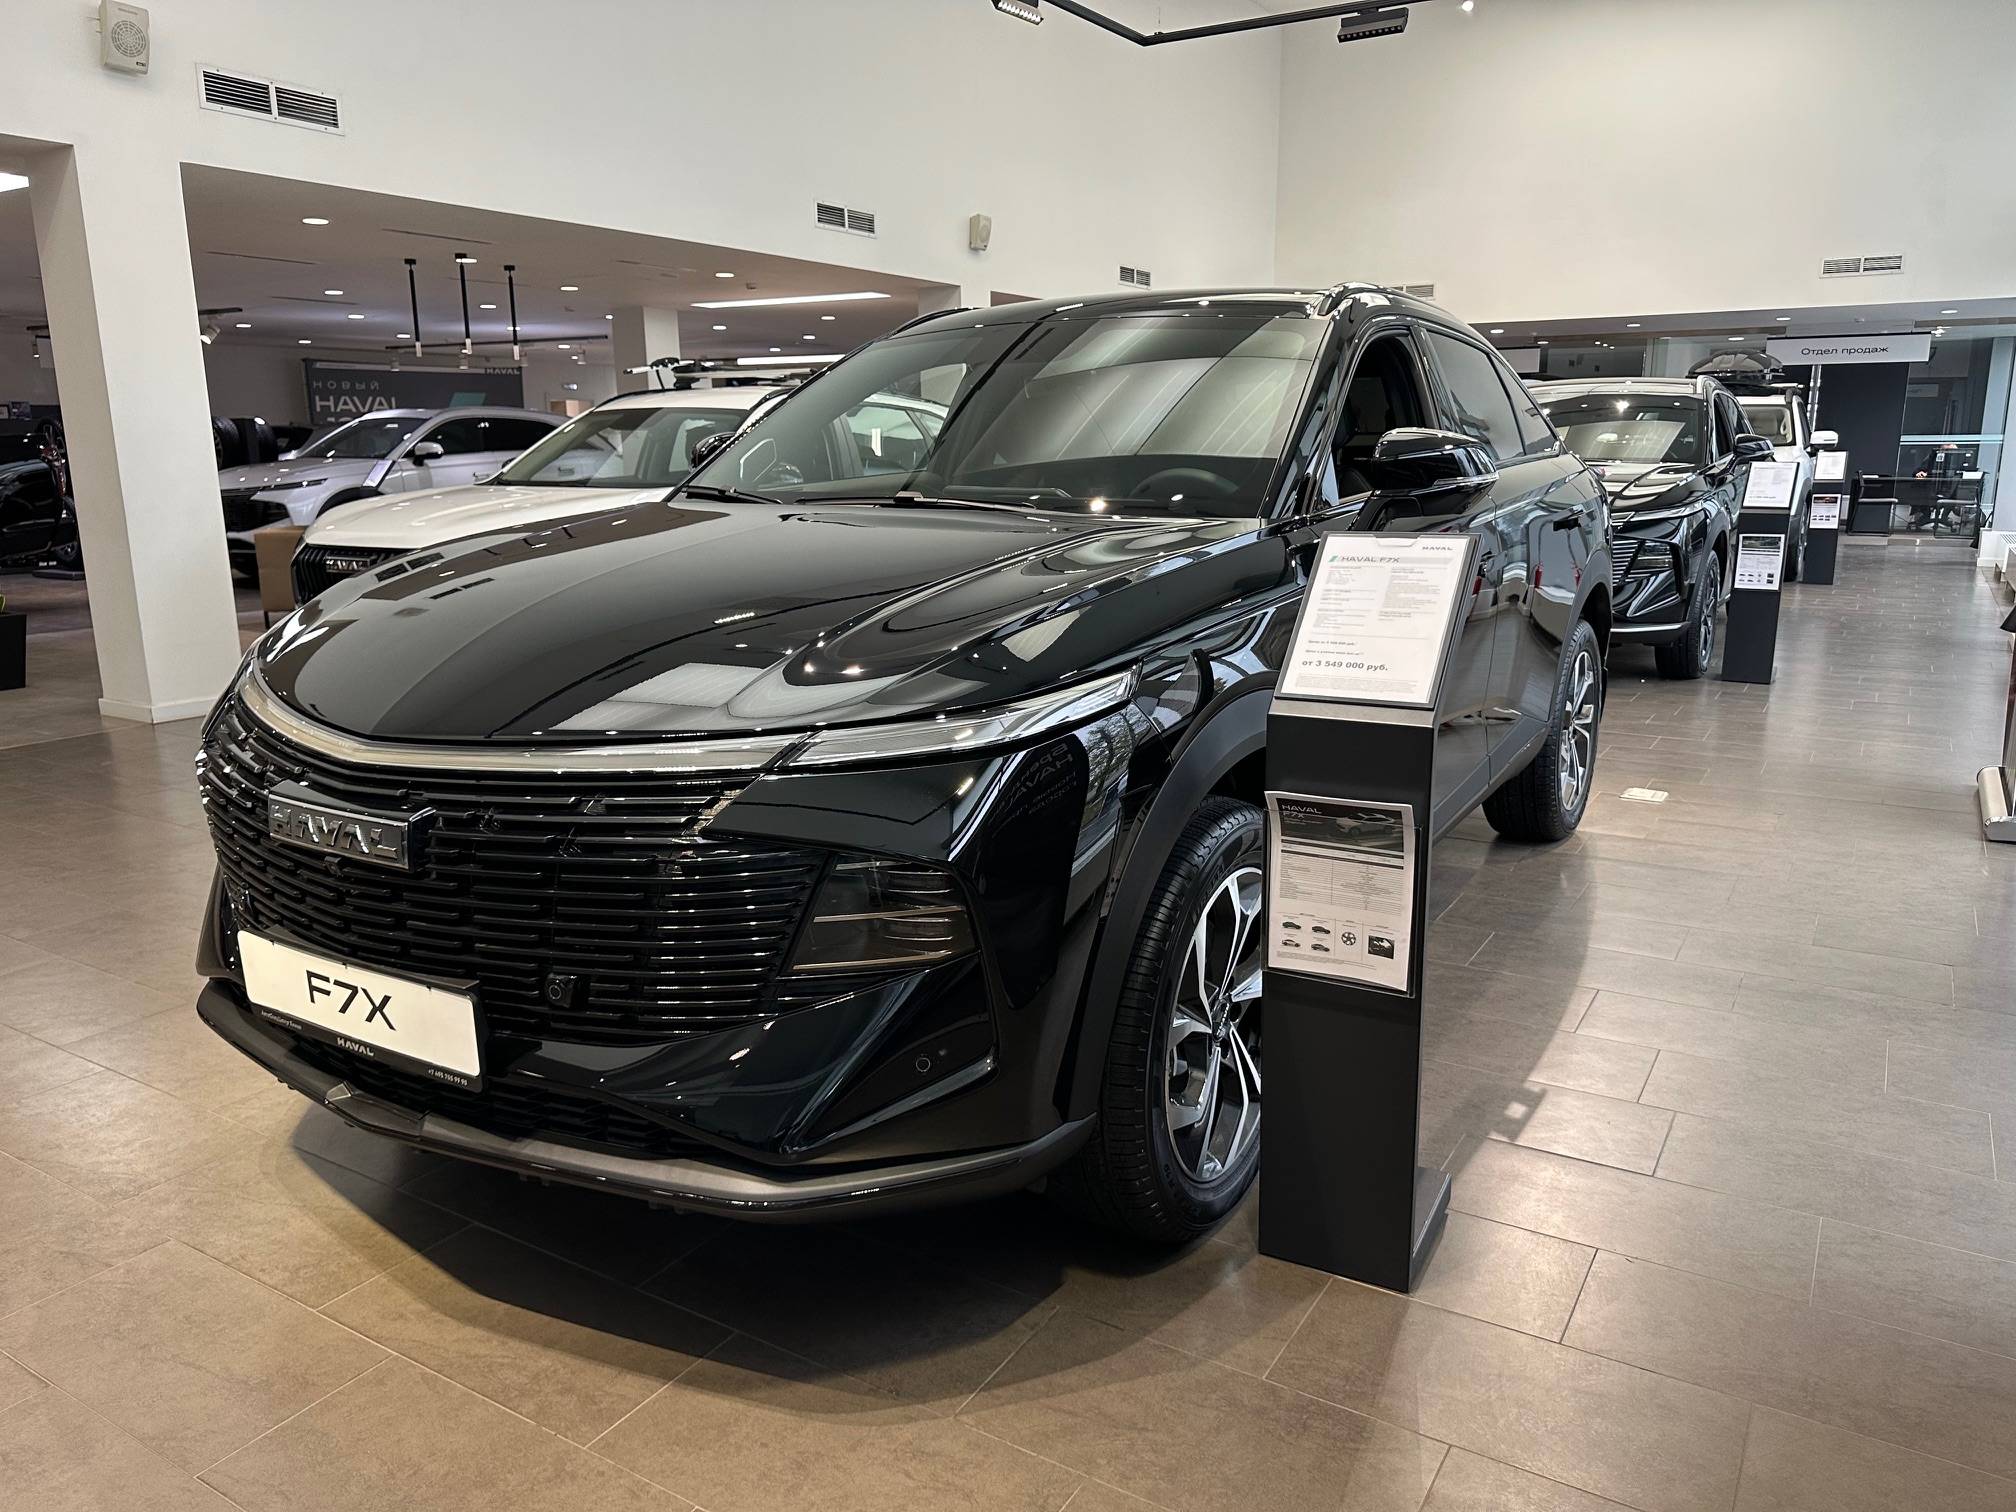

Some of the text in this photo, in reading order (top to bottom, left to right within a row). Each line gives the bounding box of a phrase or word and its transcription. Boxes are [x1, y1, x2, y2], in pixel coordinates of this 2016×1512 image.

[1801, 345, 1888, 356] Отдел продаж
[313, 380, 379, 390] НОВЫЙ
[1282, 804, 1322, 814] HAVAL
[271, 804, 398, 858] HAVAL
[306, 970, 397, 1031] F7X
[337, 1037, 375, 1056] HAVAL
